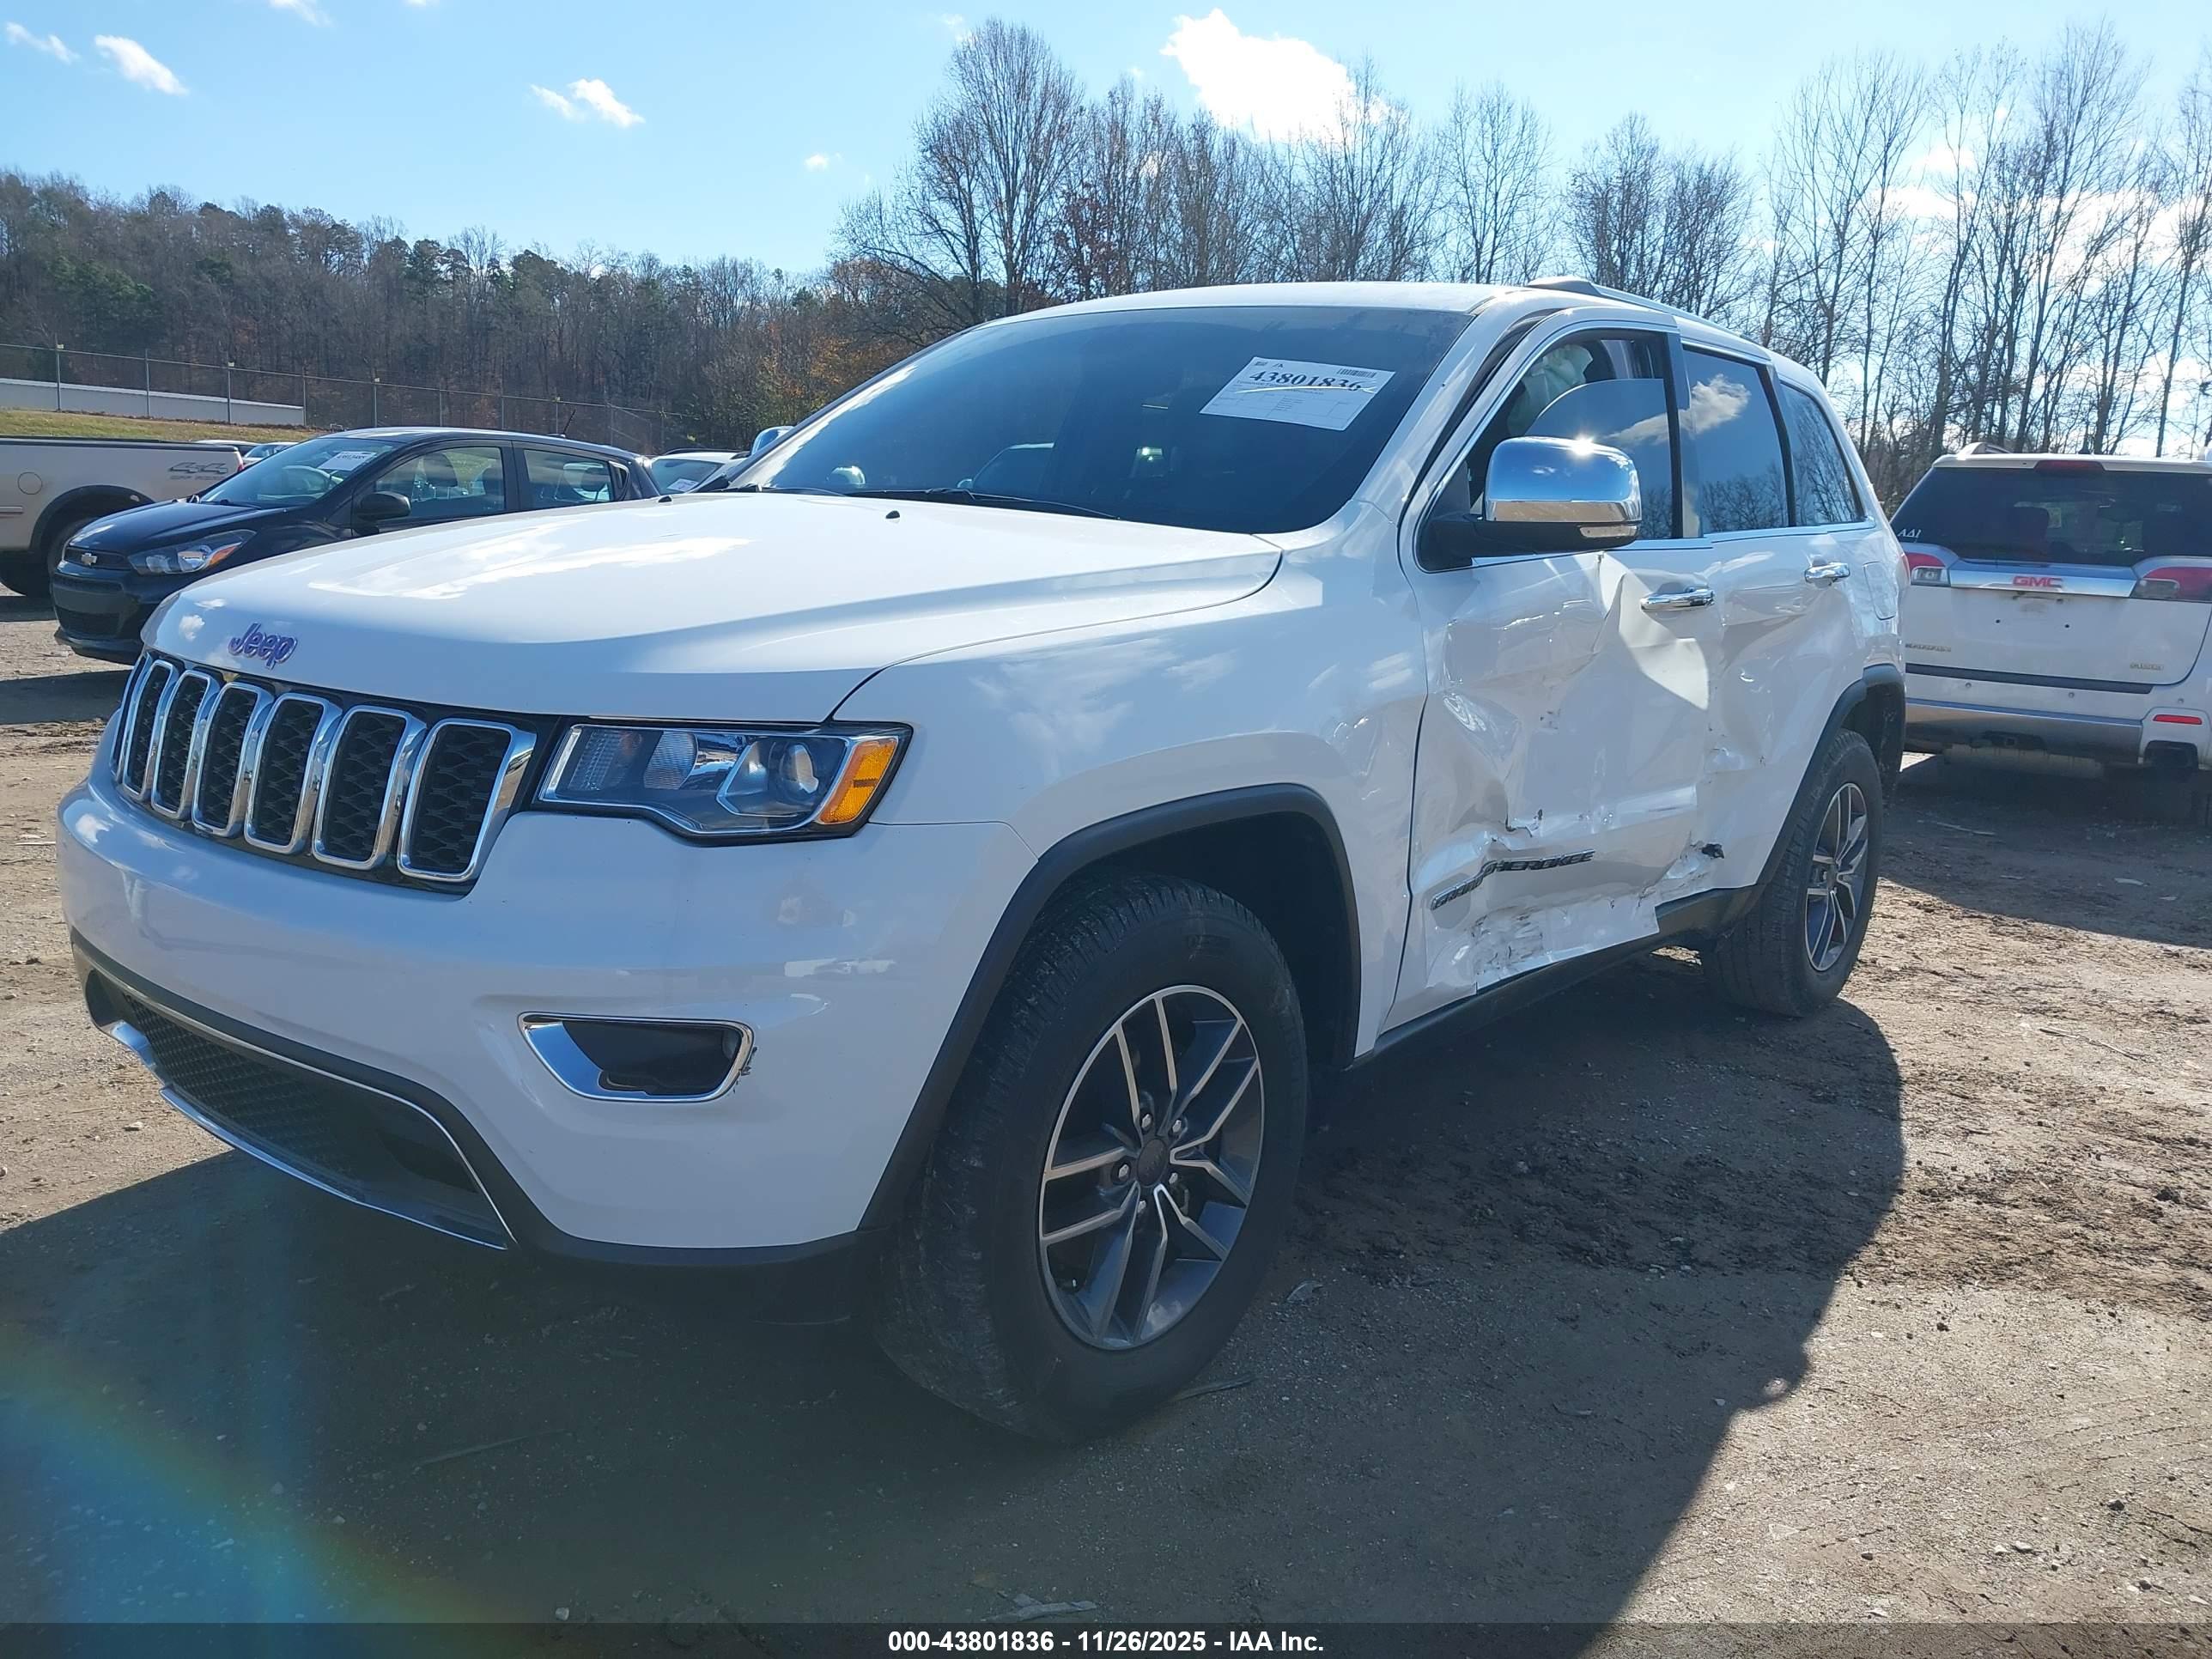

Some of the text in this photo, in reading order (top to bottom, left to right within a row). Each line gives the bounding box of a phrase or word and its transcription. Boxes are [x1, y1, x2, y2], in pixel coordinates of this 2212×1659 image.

[1249, 370, 1366, 392] 43801836
[2012, 575, 2063, 589] GMC
[227, 622, 298, 670] Jeep
